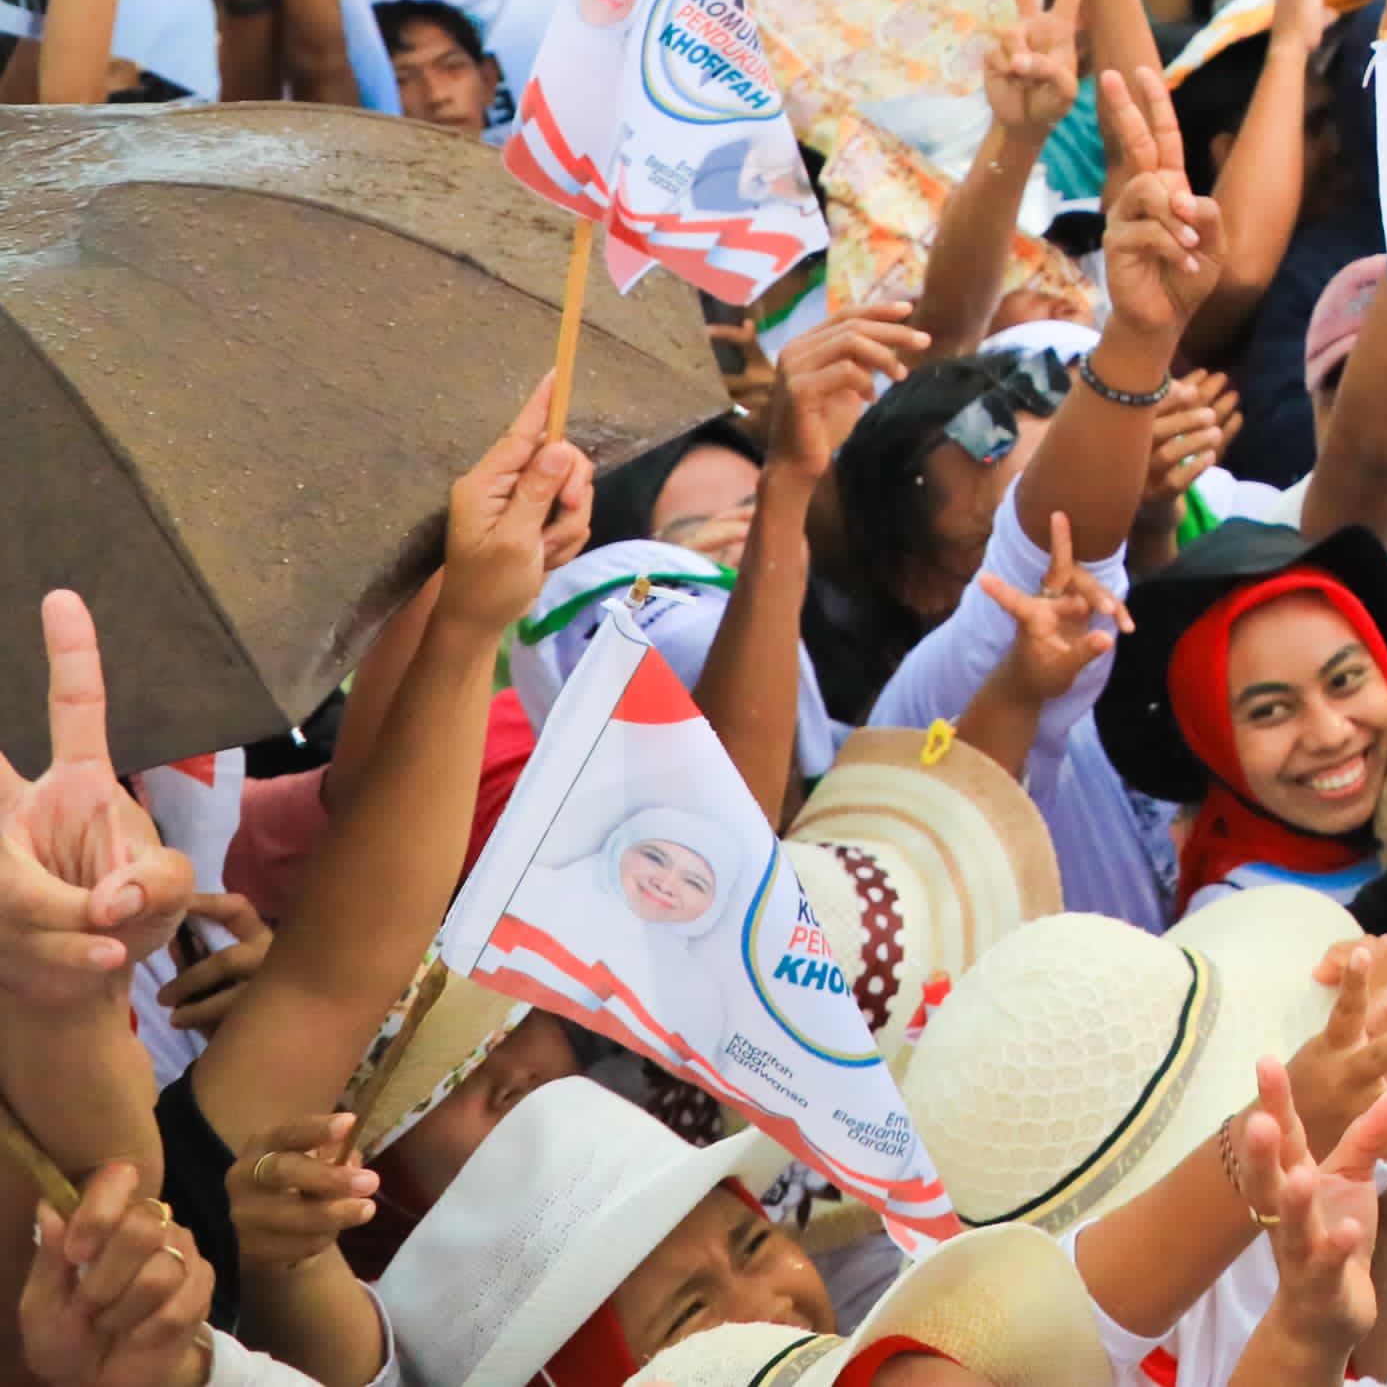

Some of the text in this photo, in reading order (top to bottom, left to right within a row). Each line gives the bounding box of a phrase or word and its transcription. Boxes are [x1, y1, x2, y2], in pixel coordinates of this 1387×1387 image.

[658, 21, 772, 110] KHOFIFAH
[773, 953, 851, 998] KHO
[724, 1045, 810, 1110] Parawansa
[733, 1032, 794, 1080] Khofifah
[846, 1128, 907, 1159] Dardak
